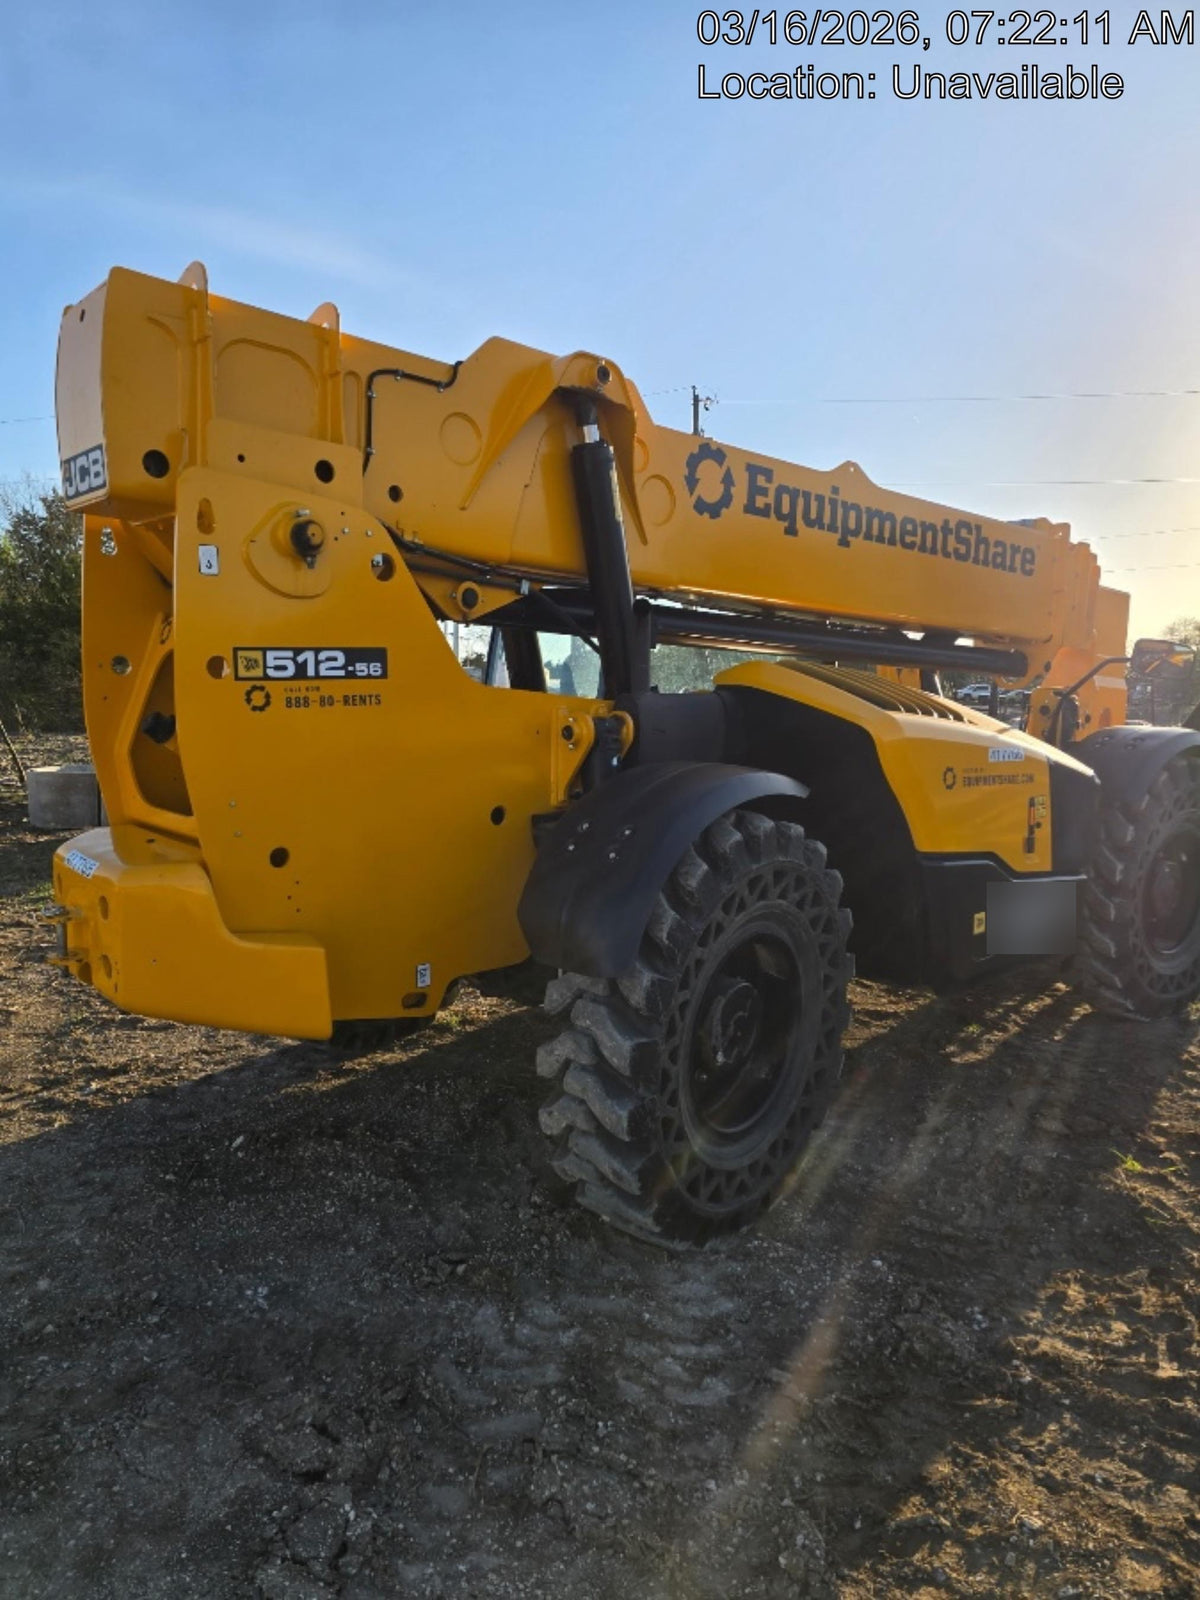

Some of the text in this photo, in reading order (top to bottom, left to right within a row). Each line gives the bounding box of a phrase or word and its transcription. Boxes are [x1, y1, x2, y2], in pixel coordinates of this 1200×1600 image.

[65, 449, 105, 497] JCB
[743, 462, 1036, 577] EquipmentShare
[285, 694, 381, 709] 888-80-RENTS
